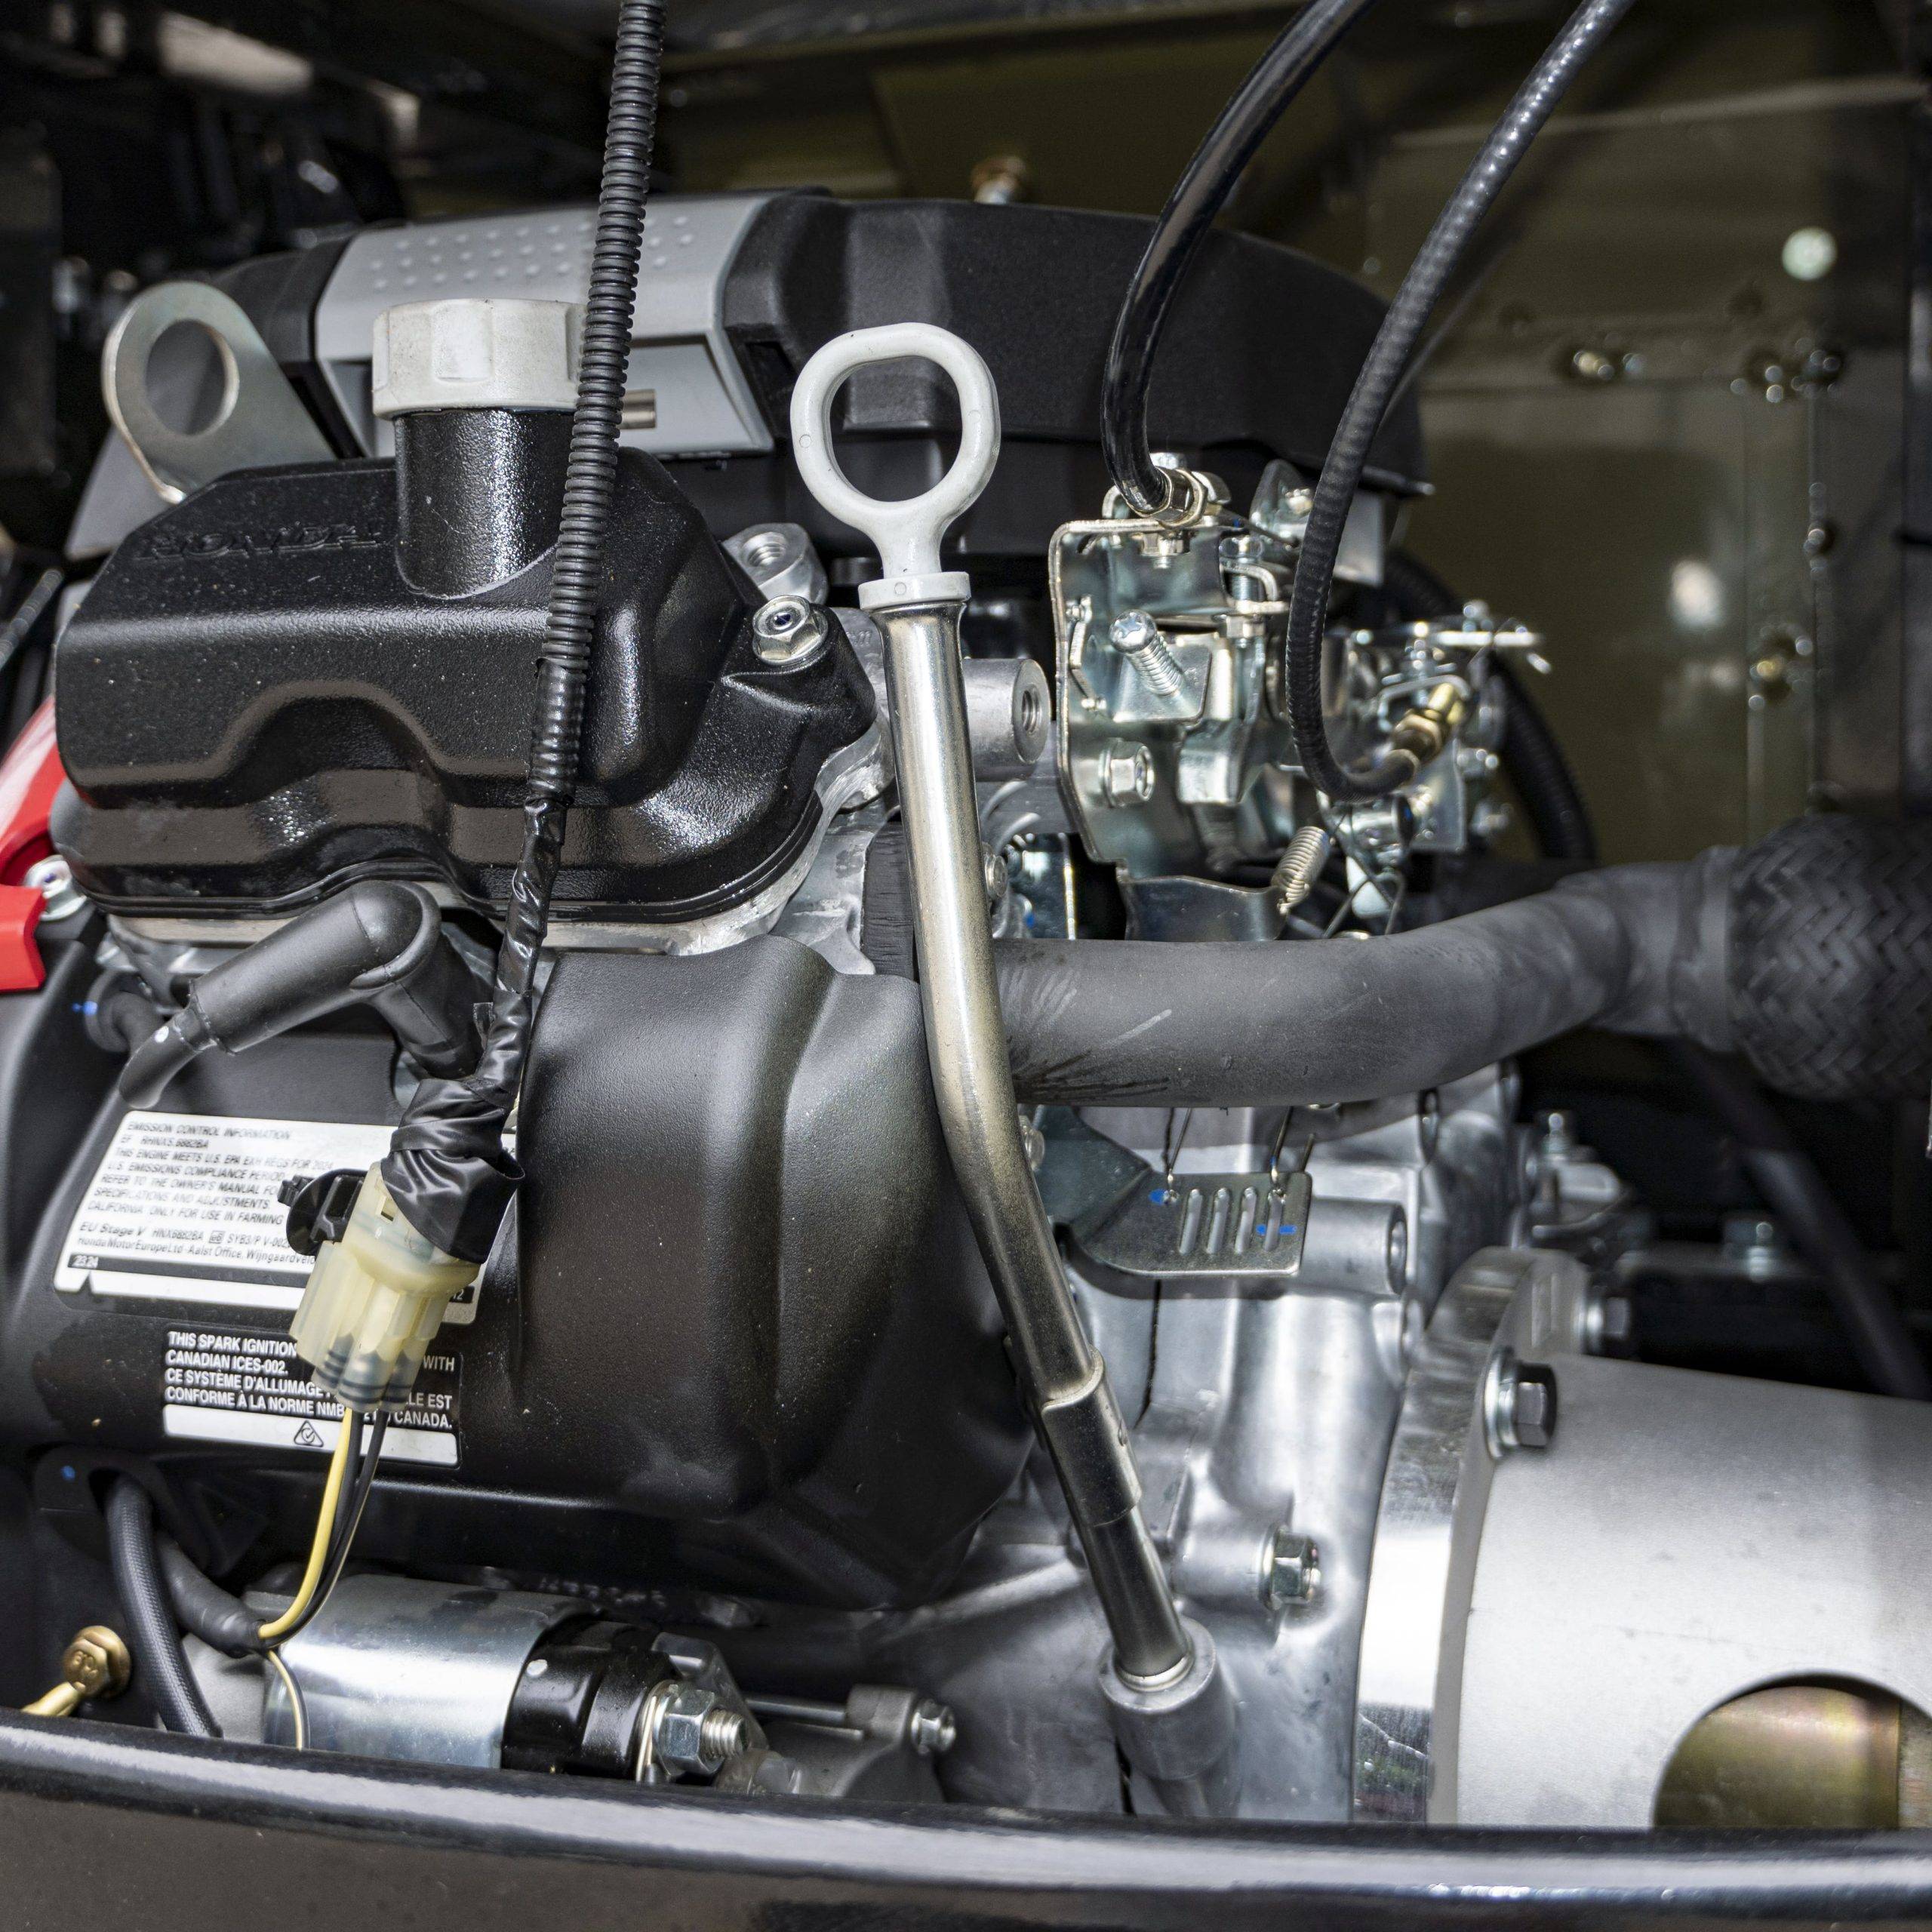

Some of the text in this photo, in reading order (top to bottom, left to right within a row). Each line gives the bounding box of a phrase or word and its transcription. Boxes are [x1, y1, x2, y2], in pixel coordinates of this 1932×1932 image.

[128, 1121, 291, 1140] EMISSION CONTROL INFORMATION
[137, 1149, 170, 1160] ENGINE
[172, 1151, 203, 1162] MEETS
[224, 1154, 241, 1164] EPA
[291, 1158, 311, 1169] FOR
[128, 1162, 183, 1174] EMISSIONS
[184, 1165, 248, 1179] COMPLIANCE
[101, 1174, 131, 1184] REFER
[134, 1176, 146, 1186] TO
[152, 1177, 169, 1187] THE
[218, 1181, 260, 1194] MANUAL
[172, 1192, 194, 1203] AND
[179, 1208, 198, 1218] FOR
[201, 1209, 221, 1220] USE
[224, 1211, 235, 1221] IN
[238, 1212, 285, 1225] FARMING
[79, 1221, 97, 1232] EU
[100, 1223, 134, 1236] Stage
[168, 1331, 196, 1349] THIS
[198, 1334, 241, 1352] SPARK
[423, 1355, 454, 1372] WITH
[165, 1349, 288, 1376] CANADIAN ICES-002.
[165, 1367, 183, 1385] CE
[184, 1370, 242, 1391] SYSTÈME
[427, 1394, 453, 1411] EST
[165, 1386, 235, 1407] CONFORME
[236, 1390, 248, 1410] À
[248, 1394, 266, 1411] LA
[267, 1396, 315, 1417] NORME
[394, 1411, 453, 1429] CANADA.
